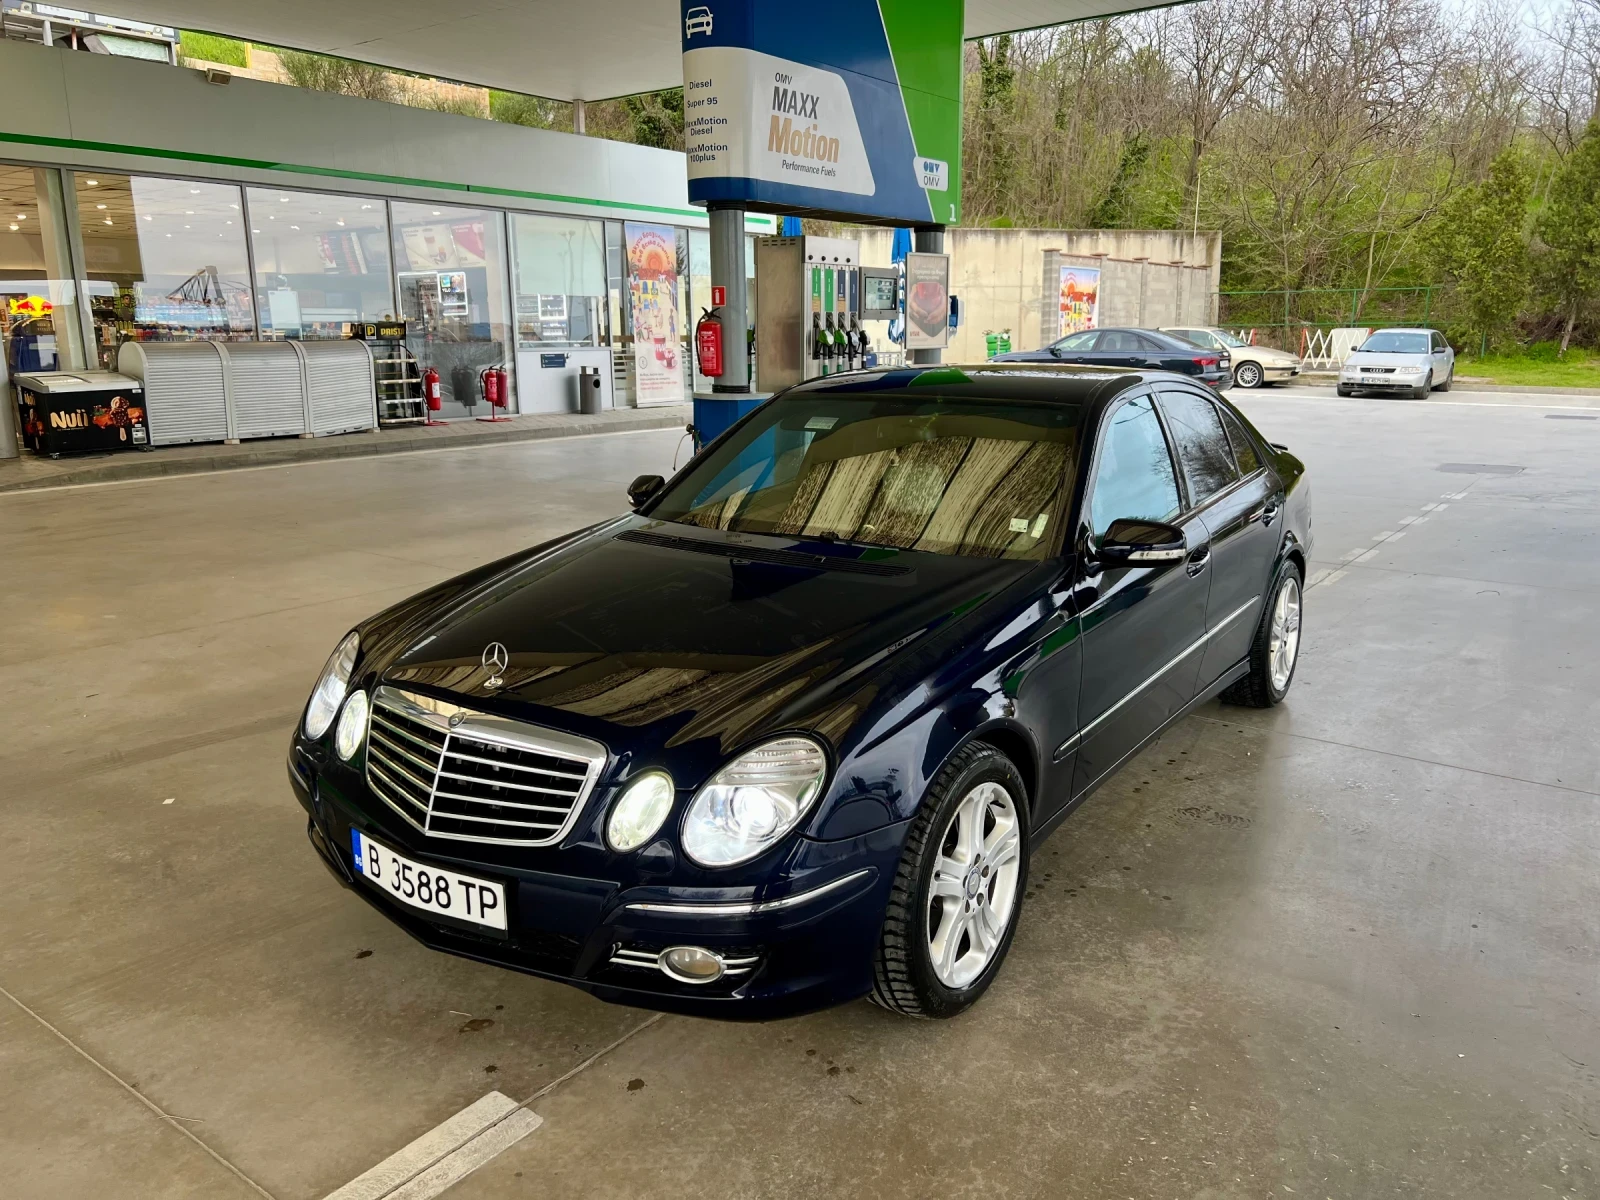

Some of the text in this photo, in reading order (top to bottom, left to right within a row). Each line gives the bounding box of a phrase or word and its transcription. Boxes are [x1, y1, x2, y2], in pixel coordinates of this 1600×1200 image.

[689, 79, 712, 90] Diesel
[775, 72, 793, 85] OMV
[687, 97, 718, 109] Super 95
[772, 86, 820, 120] MAXX
[690, 126, 713, 137] Diesel
[767, 114, 840, 164] Motion
[690, 153, 716, 164] 100plus
[781, 159, 837, 178] Performance Fuels
[923, 160, 940, 174] OMV
[923, 175, 940, 187] OMV
[949, 203, 957, 223] 1
[354, 853, 363, 867] BG
[368, 843, 498, 919] B 3588 TP
